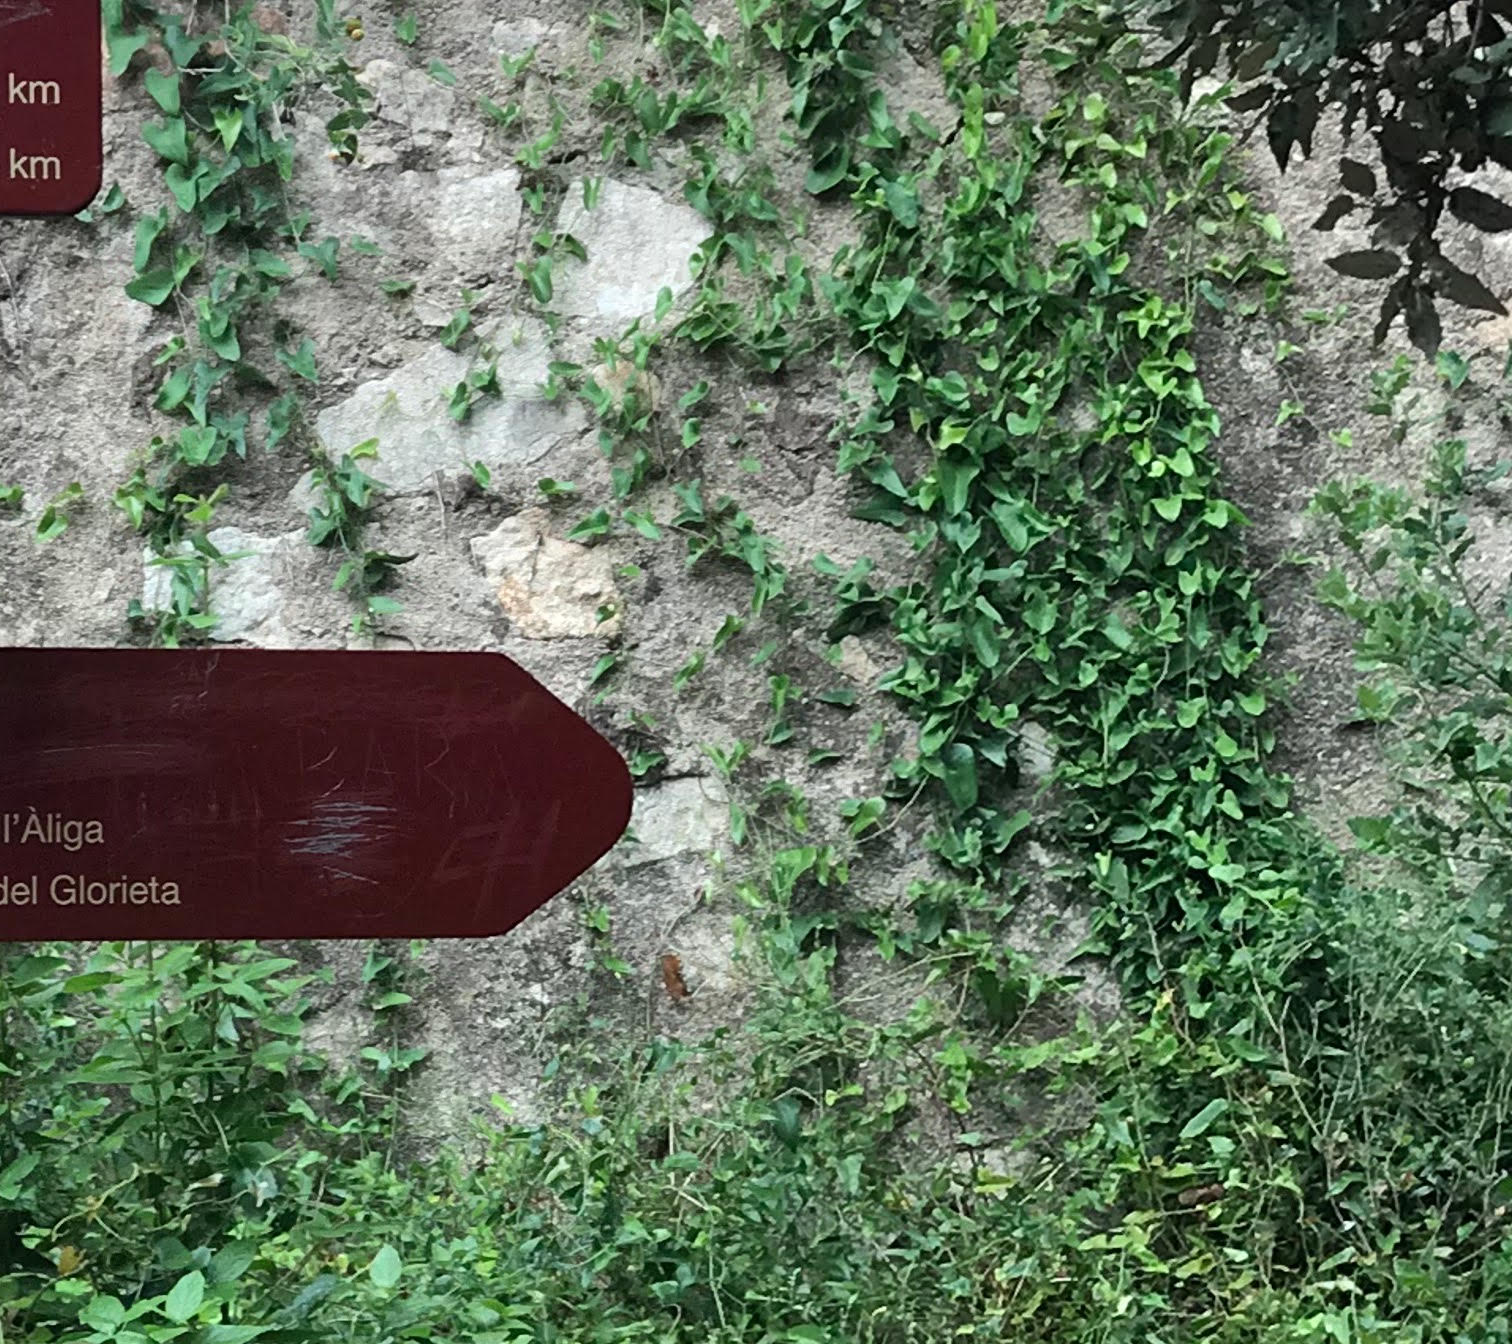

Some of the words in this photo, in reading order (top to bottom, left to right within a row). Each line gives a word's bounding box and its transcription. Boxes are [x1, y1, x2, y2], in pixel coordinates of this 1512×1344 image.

[8, 73, 62, 105] km
[9, 148, 62, 180] km
[49, 873, 181, 906] Glorieta
